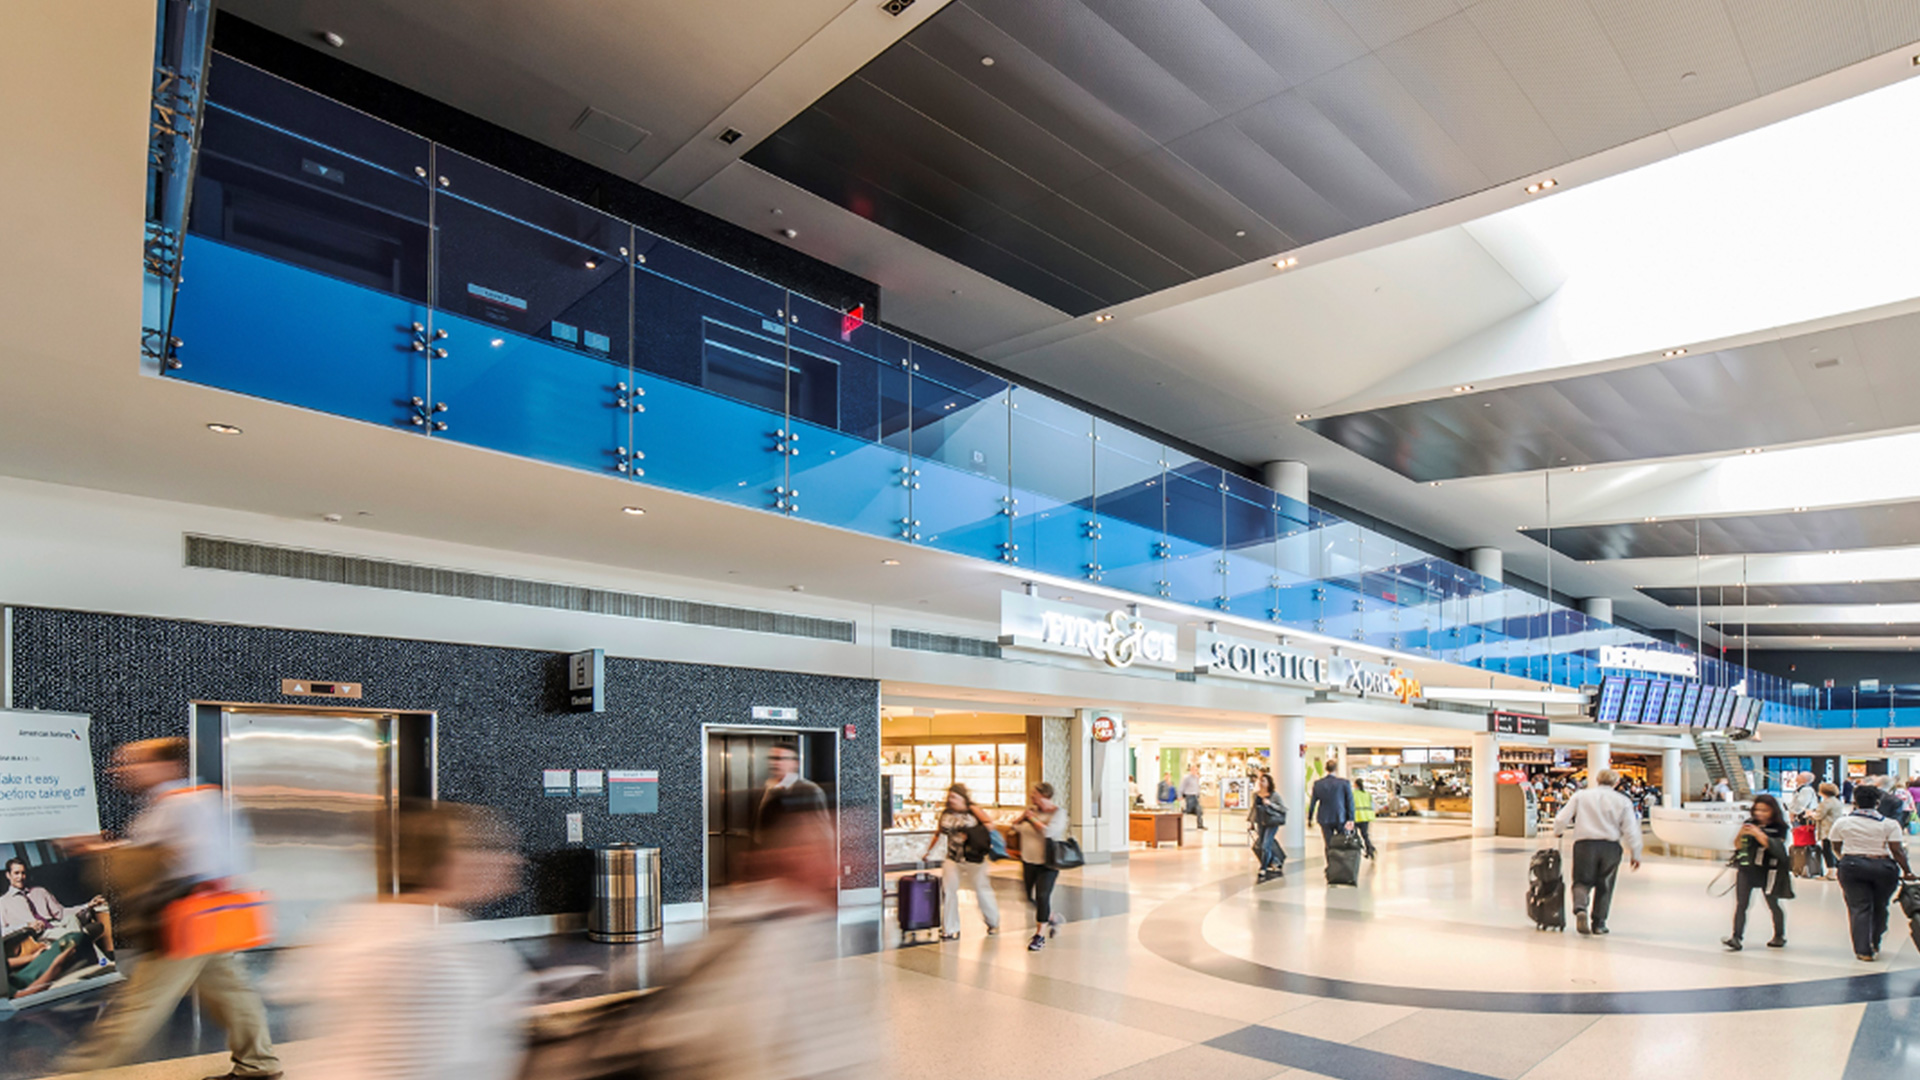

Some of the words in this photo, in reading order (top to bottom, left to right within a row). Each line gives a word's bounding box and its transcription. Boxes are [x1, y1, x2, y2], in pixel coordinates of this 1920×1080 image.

[1104, 609, 1144, 668] &
[1211, 641, 1329, 684] SOLSTICE
[1600, 646, 1696, 675] DEPAS
[0, 773, 22, 785] ake
[34, 775, 59, 787] easy
[39, 787, 72, 800] taking
